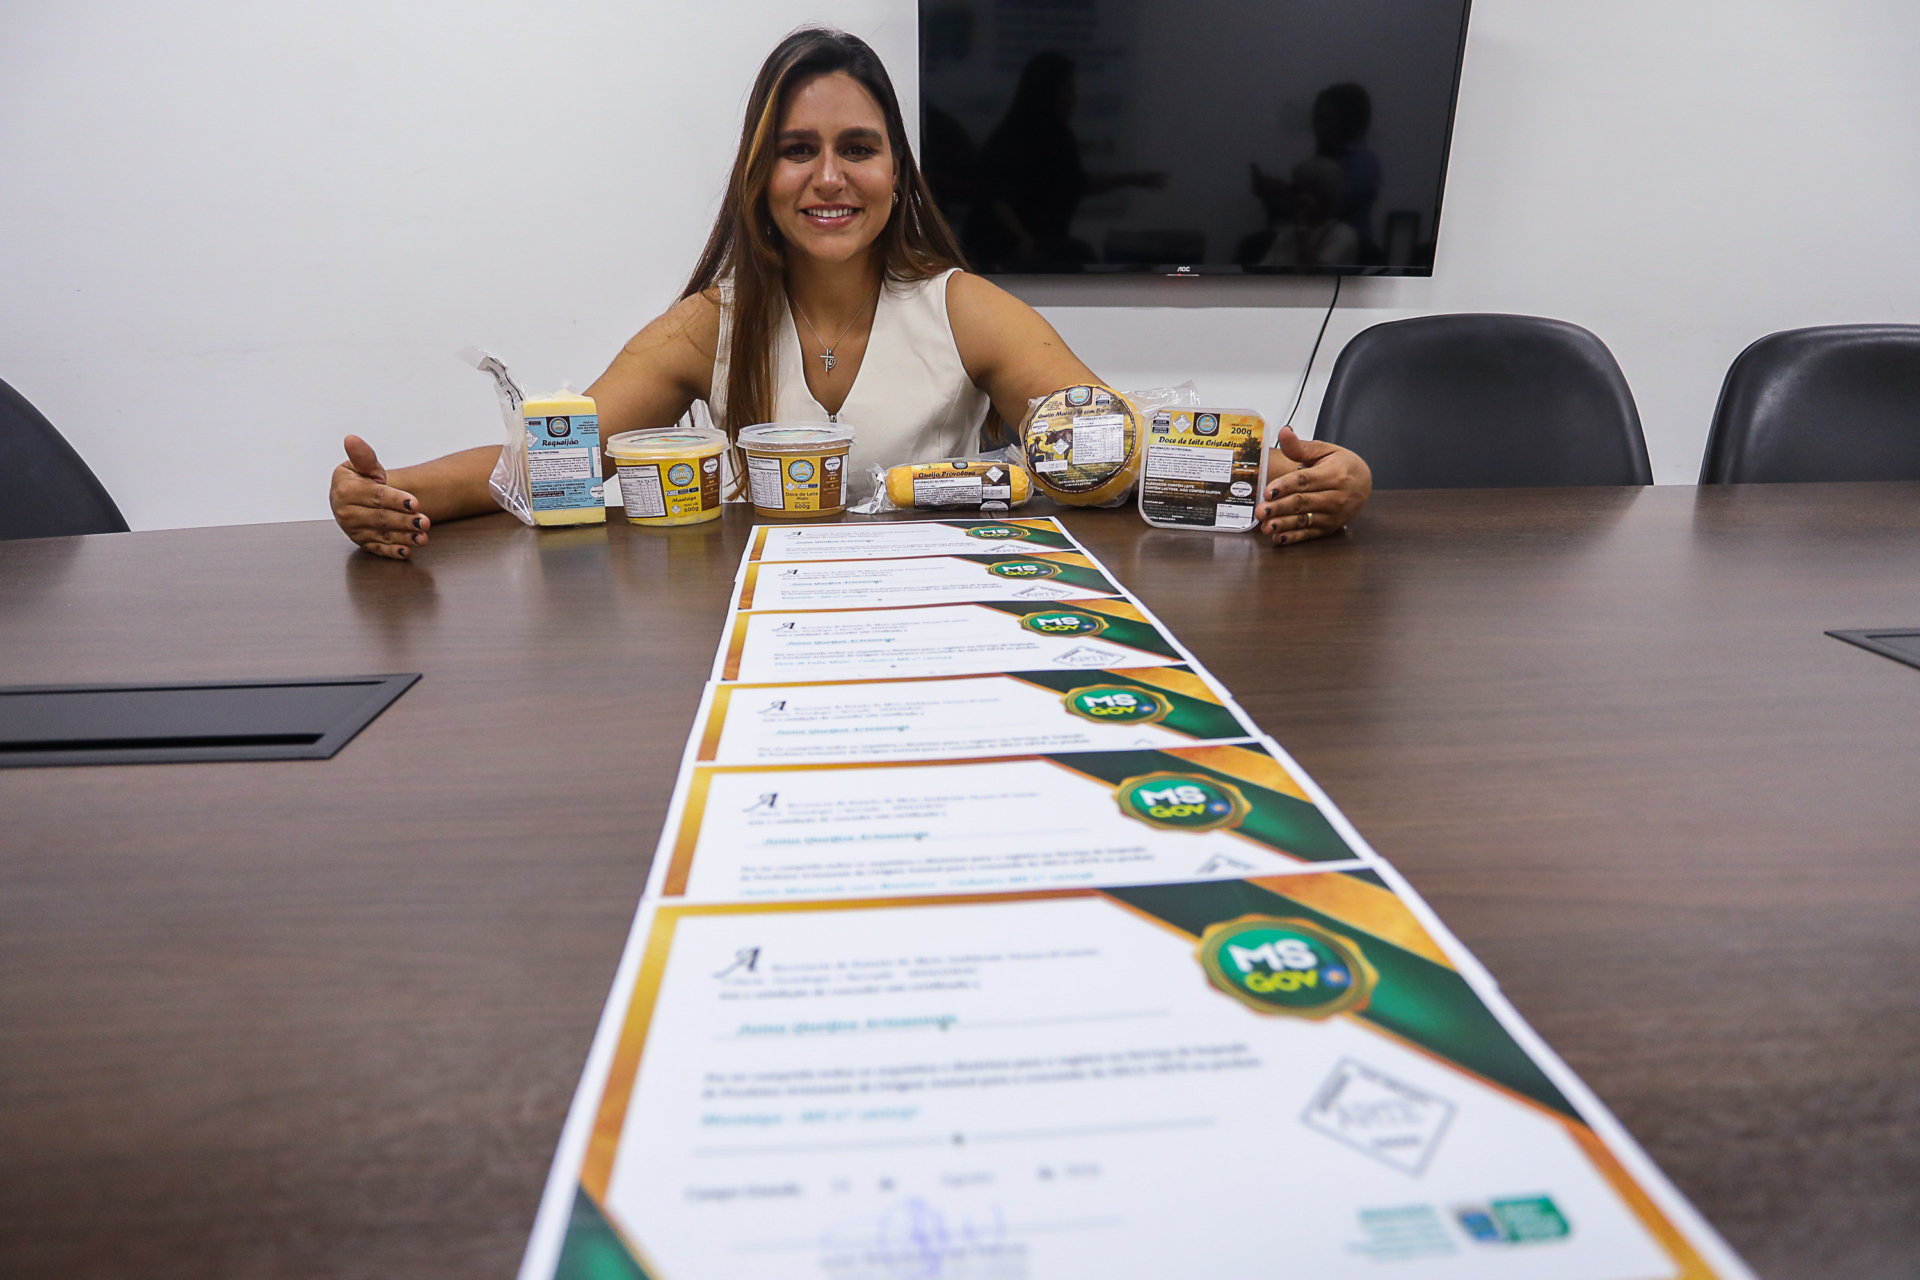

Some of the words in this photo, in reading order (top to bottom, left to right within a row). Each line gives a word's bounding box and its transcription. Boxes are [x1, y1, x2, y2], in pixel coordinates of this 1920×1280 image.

[1231, 427, 1252, 436] 200g
[542, 438, 578, 448] Requeijão
[1037, 617, 1080, 626] MS
[1083, 694, 1137, 708] MS
[1090, 706, 1136, 716] GOV
[1139, 786, 1206, 806] MS
[1149, 804, 1206, 818] GOV
[1228, 938, 1319, 974] MS
[1244, 966, 1318, 994] GOV
